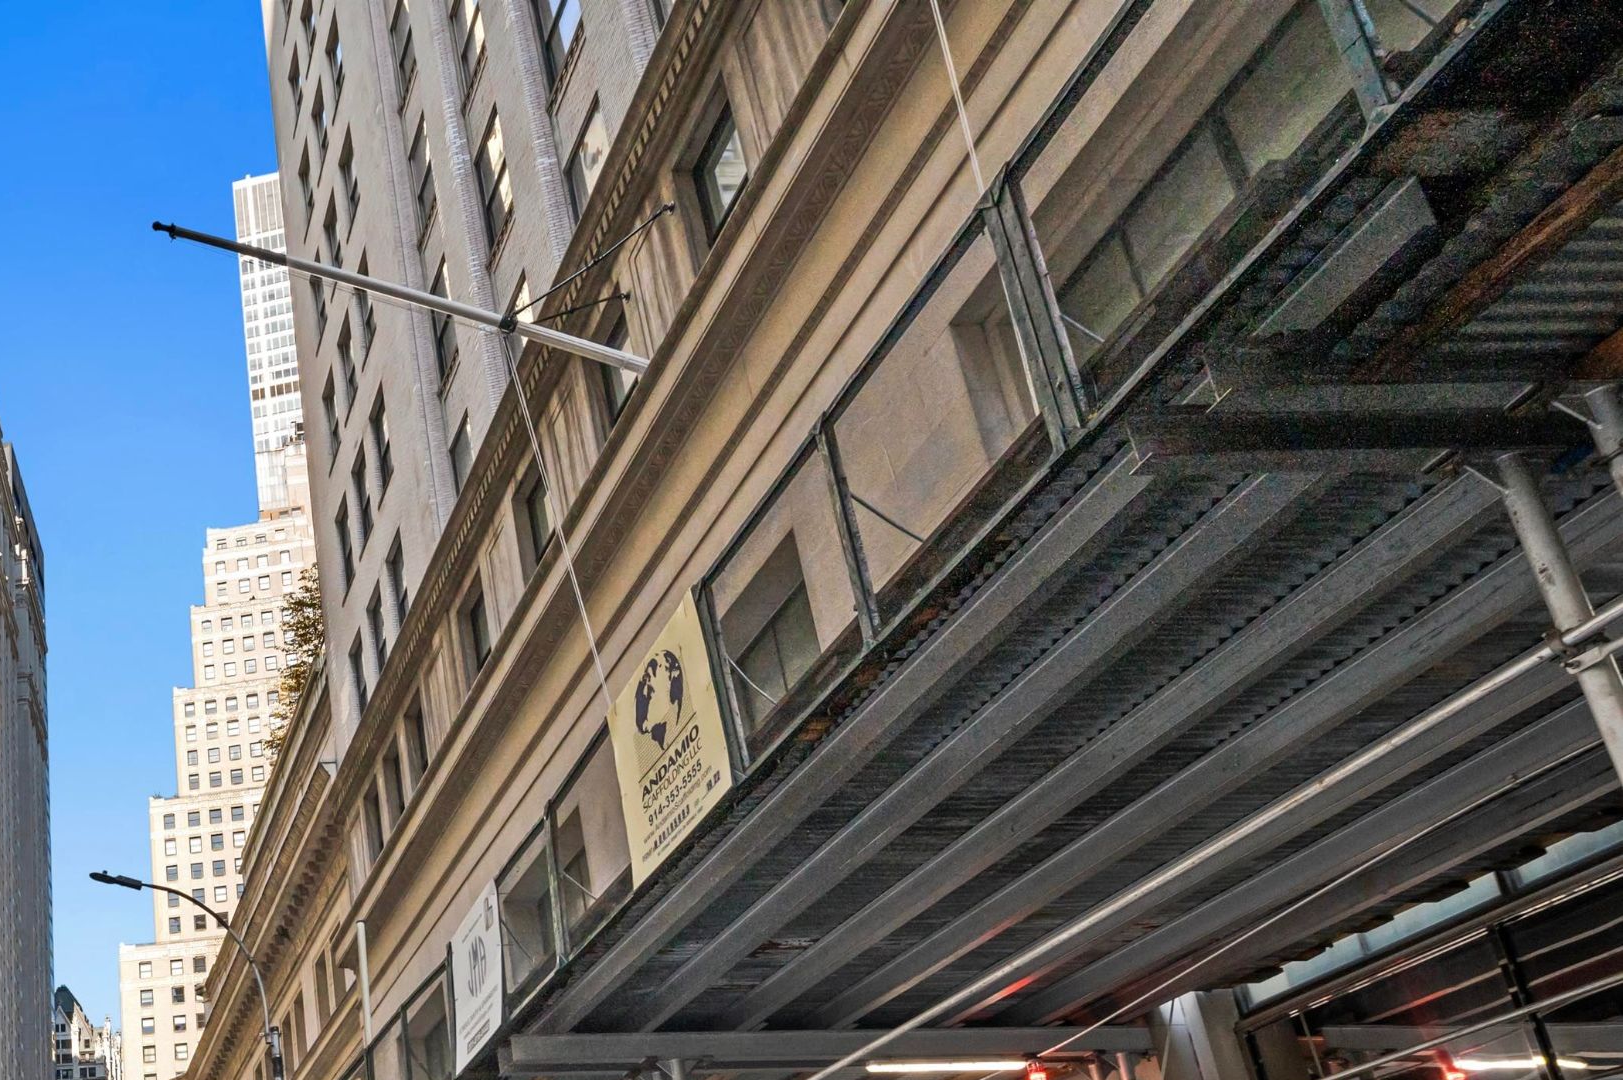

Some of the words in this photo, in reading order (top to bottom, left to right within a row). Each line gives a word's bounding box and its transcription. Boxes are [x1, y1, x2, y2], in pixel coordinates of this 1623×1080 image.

[642, 724, 699, 802] ANDAMIO
[642, 757, 690, 814] SCAFFOLDING
[689, 737, 703, 763] LLC
[648, 758, 703, 826] 914-353-5555
